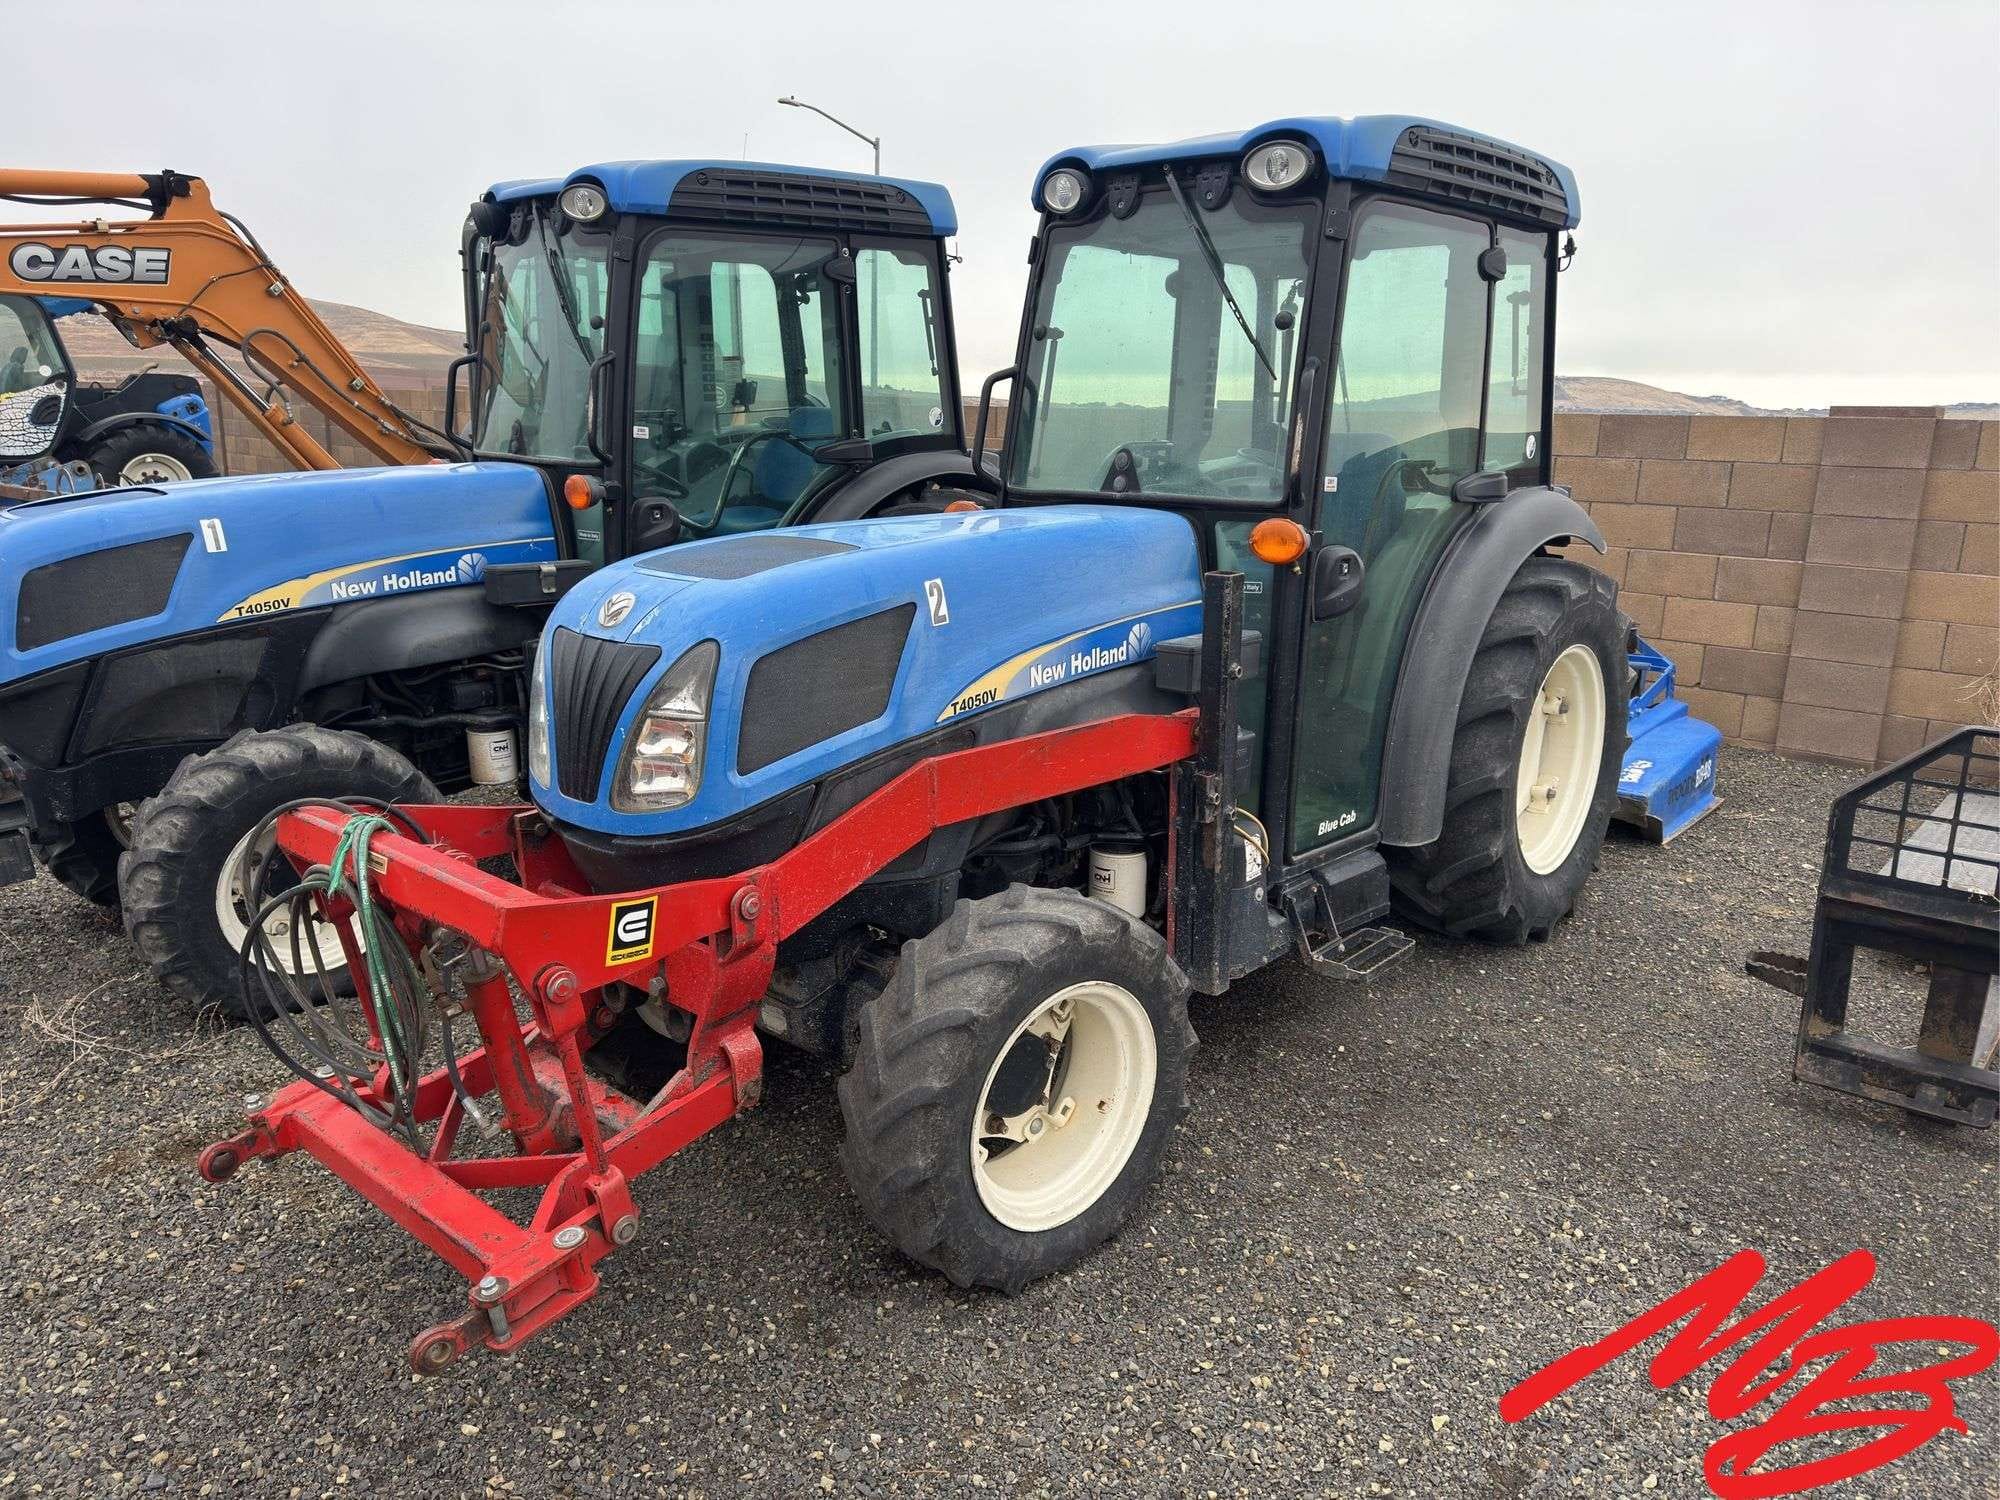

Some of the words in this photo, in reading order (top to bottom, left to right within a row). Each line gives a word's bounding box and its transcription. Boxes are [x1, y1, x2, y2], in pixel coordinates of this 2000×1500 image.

[11, 243, 169, 282] CASE
[207, 520, 221, 550] 1
[330, 580, 377, 600] New
[383, 566, 457, 591] Holland
[235, 598, 291, 617] T4050V
[929, 581, 947, 624] 2
[1030, 662, 1067, 687] New
[1070, 641, 1128, 675] Holland
[951, 688, 998, 716] T4050V
[1318, 820, 1339, 836] Blue
[1339, 810, 1357, 827] Cab
